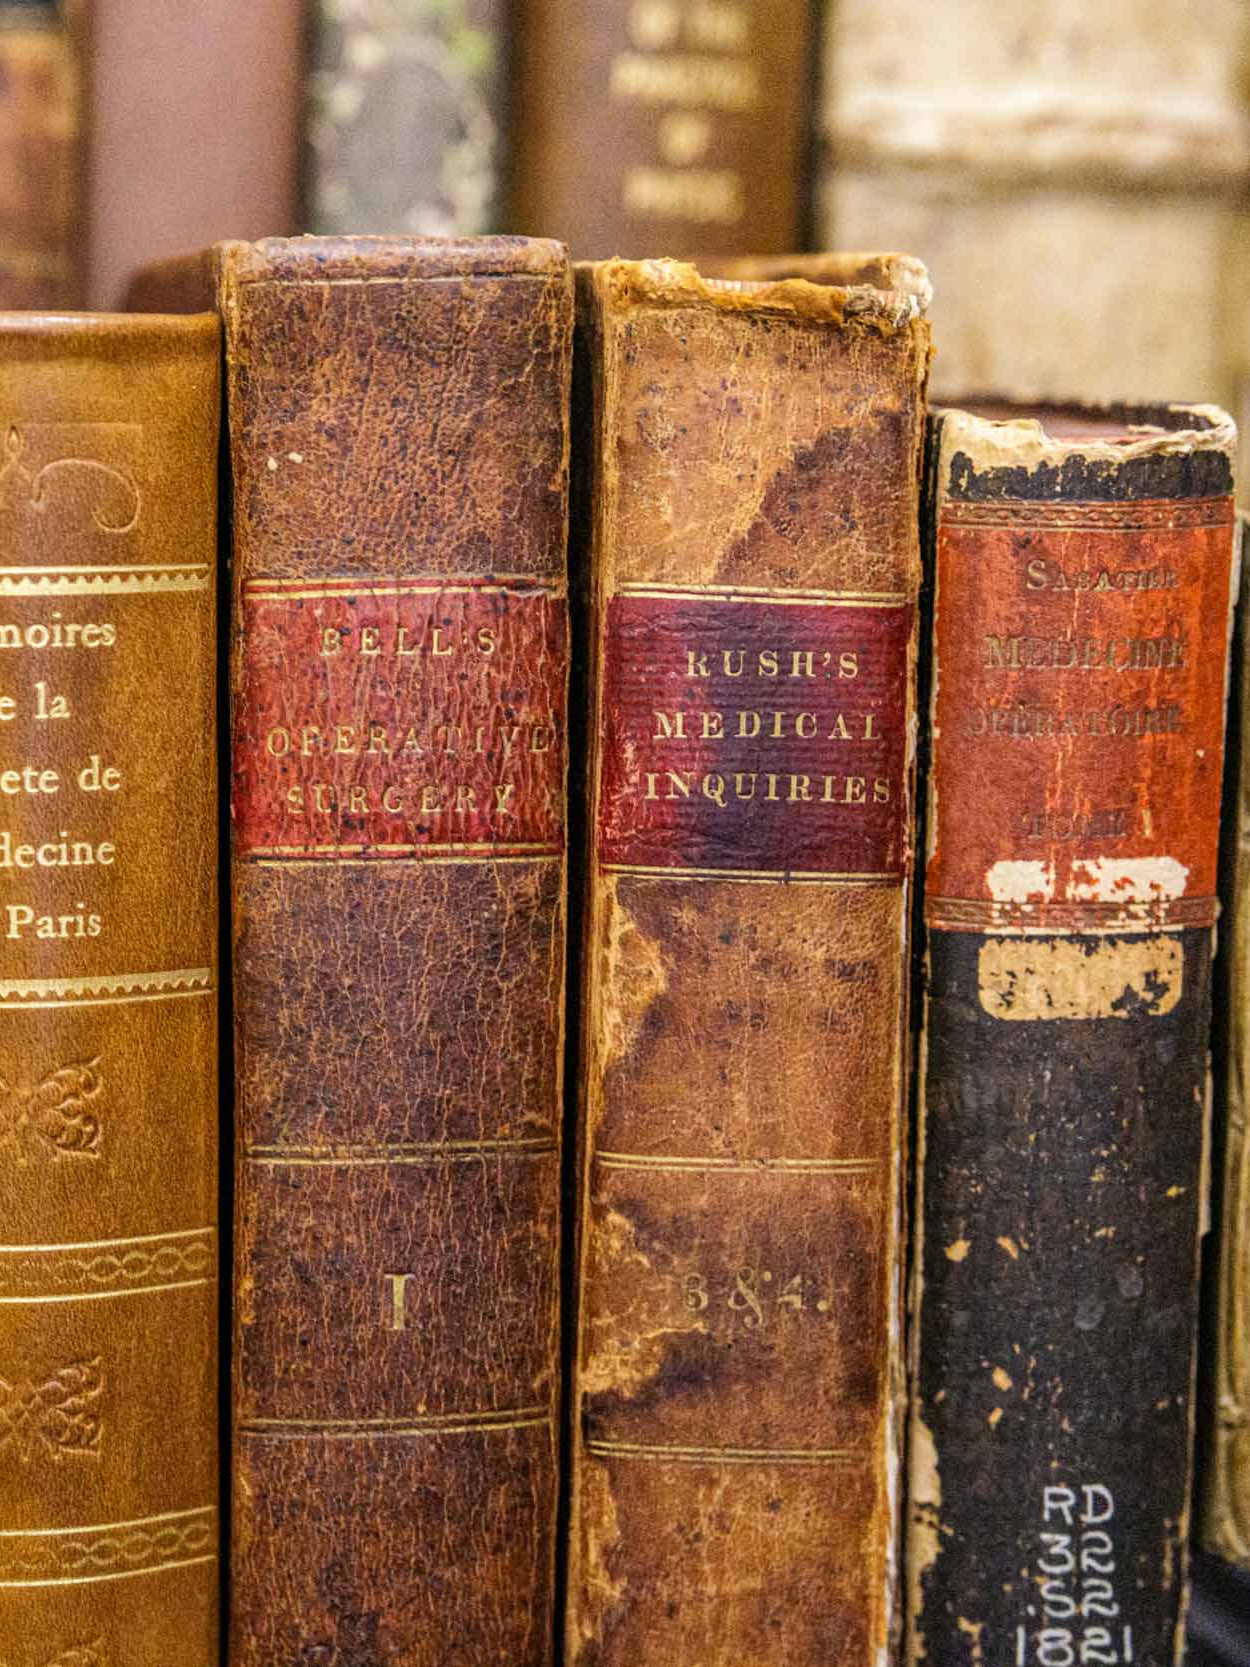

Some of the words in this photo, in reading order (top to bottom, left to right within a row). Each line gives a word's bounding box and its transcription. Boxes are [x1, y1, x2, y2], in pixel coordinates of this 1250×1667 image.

[687, 650, 859, 679] RUSH'S
[34, 681, 70, 719] la
[267, 726, 551, 757] OPERATIVE
[653, 711, 882, 740] MEDICAL
[78, 755, 121, 792] de
[644, 772, 891, 808] INQUIRIES
[285, 783, 515, 814] SURGERY
[6, 901, 101, 940] Paris
[1042, 1484, 1114, 1525] RD
[1037, 1531, 1116, 1574] 32
[1016, 1624, 1133, 1667] 1821
